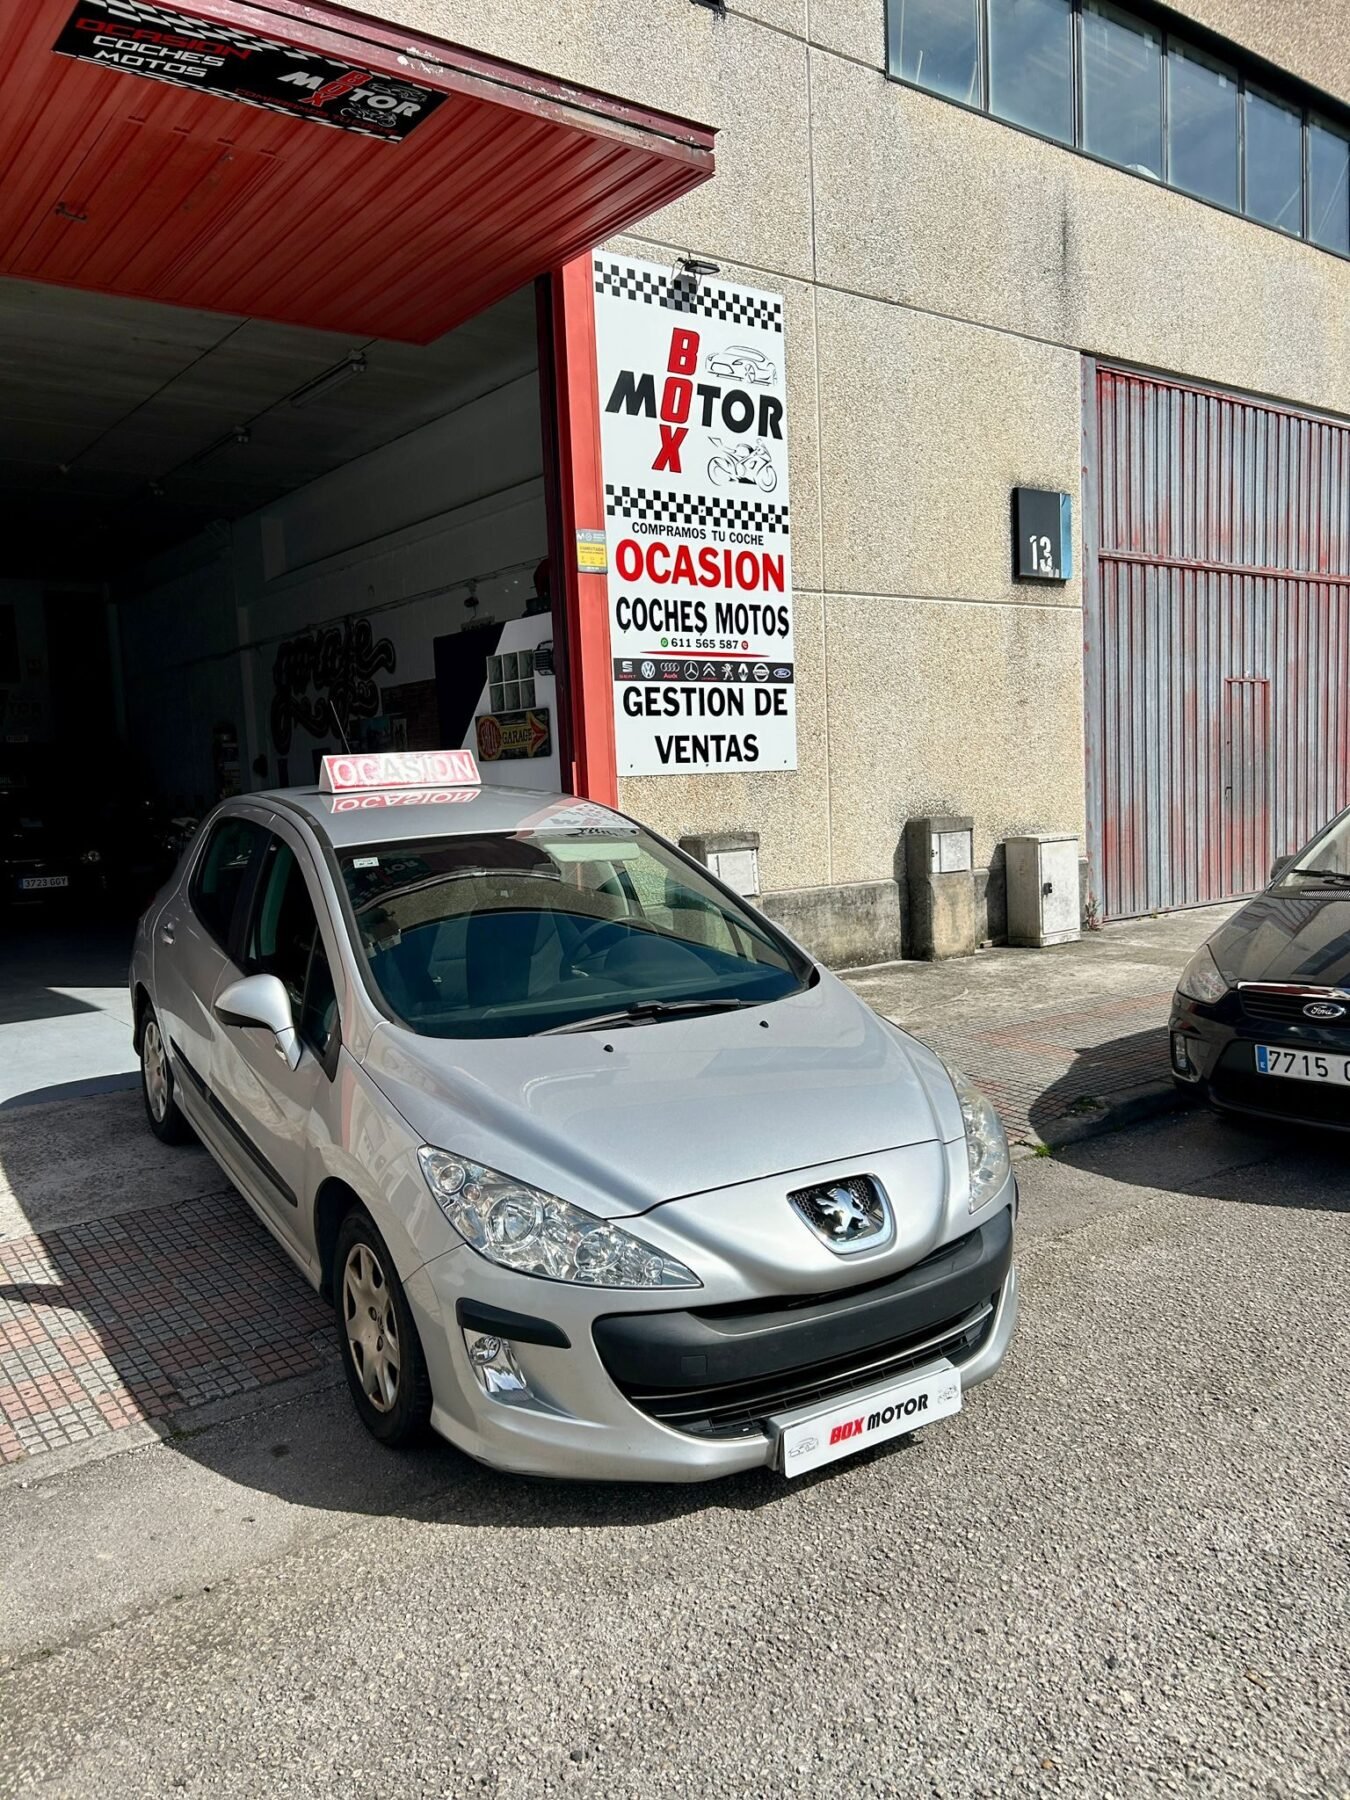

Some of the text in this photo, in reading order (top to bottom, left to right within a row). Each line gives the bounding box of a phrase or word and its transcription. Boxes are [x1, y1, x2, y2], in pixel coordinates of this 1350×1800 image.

[75, 18, 252, 60] OCASION
[93, 35, 225, 67] COCHES
[94, 50, 208, 77] MOTOS
[298, 70, 373, 107] BOX
[651, 327, 700, 473] BOX
[631, 521, 764, 546] COMPRAMOS TU COCHE
[615, 538, 784, 593] OCASION
[1029, 535, 1053, 572] 13
[616, 596, 790, 637] COCHES MOTOS
[671, 637, 739, 650] 611 565 587
[622, 686, 788, 717] GESTION DE
[502, 728, 533, 746] GARAGE
[655, 734, 759, 764] VENTAS
[333, 752, 475, 787] OCASION
[1310, 1006, 1333, 1015] Ford
[1269, 1050, 1329, 1078] 7715
[829, 1393, 928, 1446] BOX MOTOR
